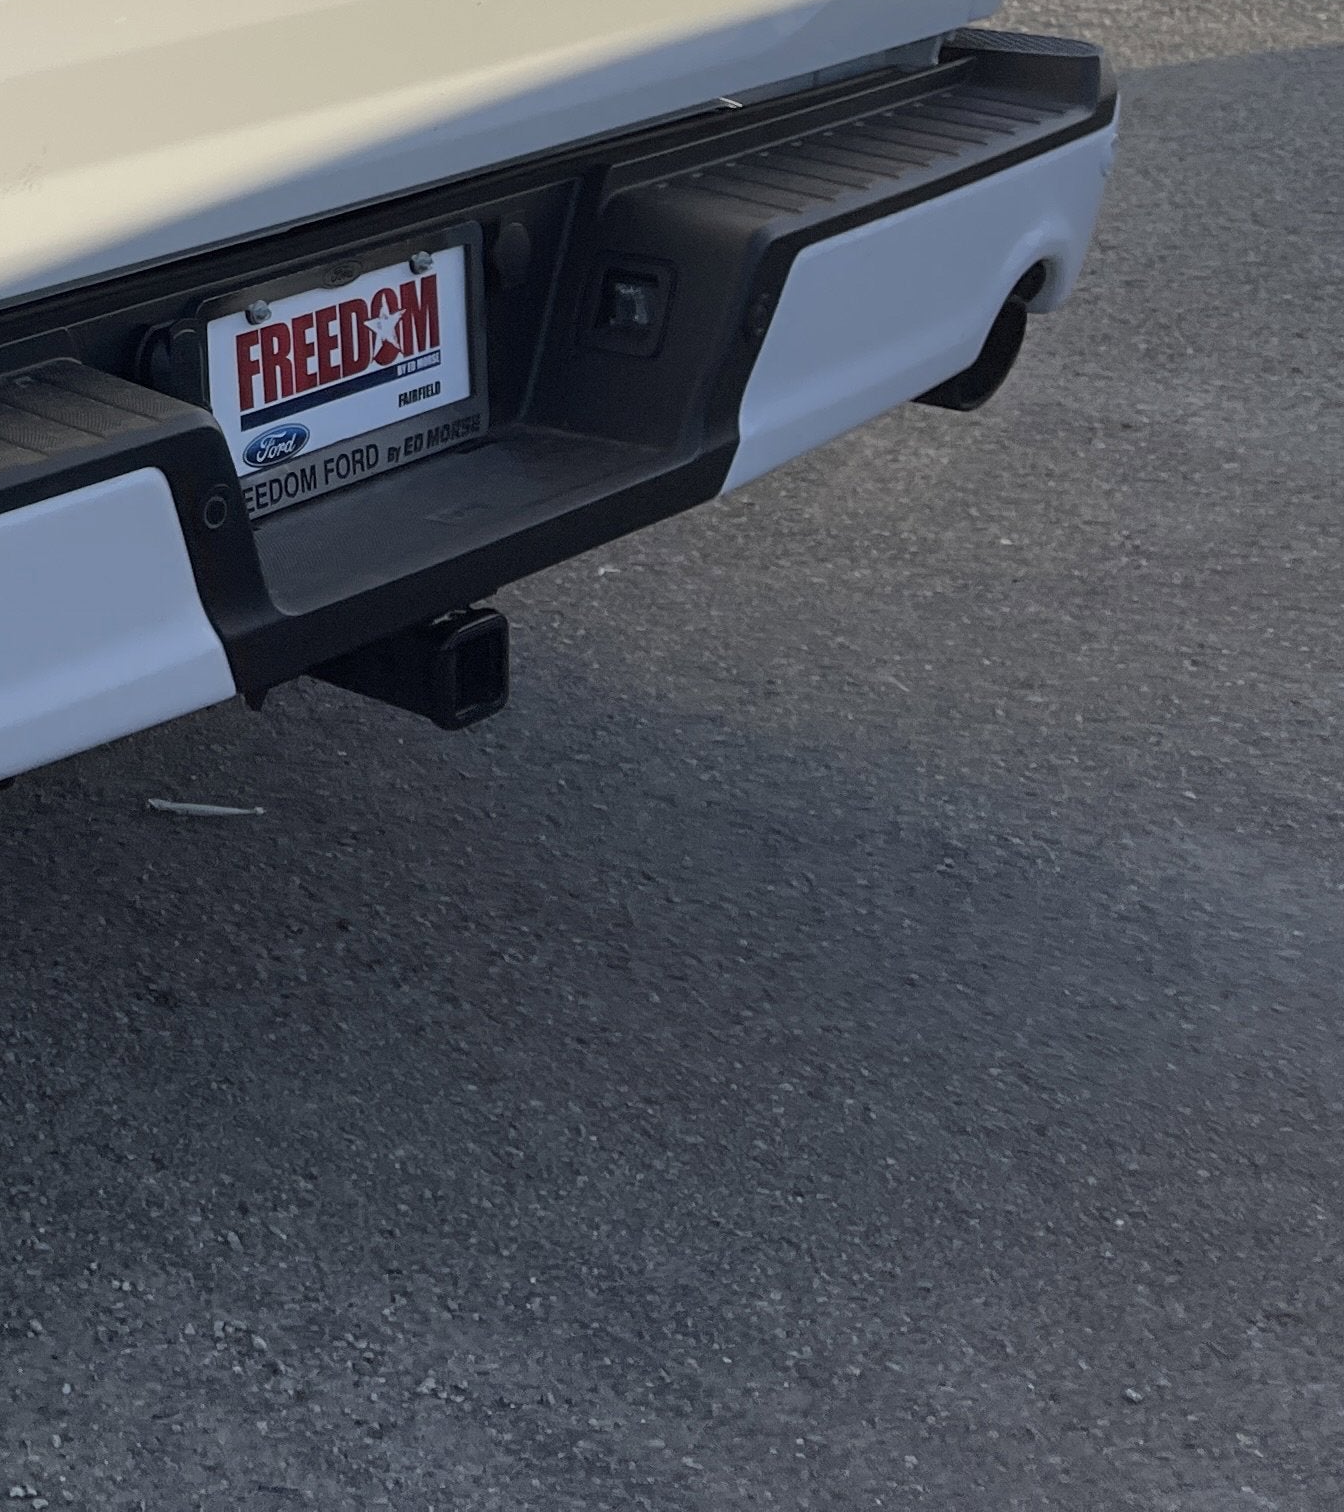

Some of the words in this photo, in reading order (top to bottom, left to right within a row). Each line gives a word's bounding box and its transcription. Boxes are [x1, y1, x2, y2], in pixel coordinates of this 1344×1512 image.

[235, 274, 441, 412] FREEDOM
[398, 380, 441, 408] FAIRFIELD
[243, 465, 317, 513] EEDOM
[324, 444, 380, 485] FORD
[403, 433, 424, 457] ED
[256, 431, 298, 462] Ford
